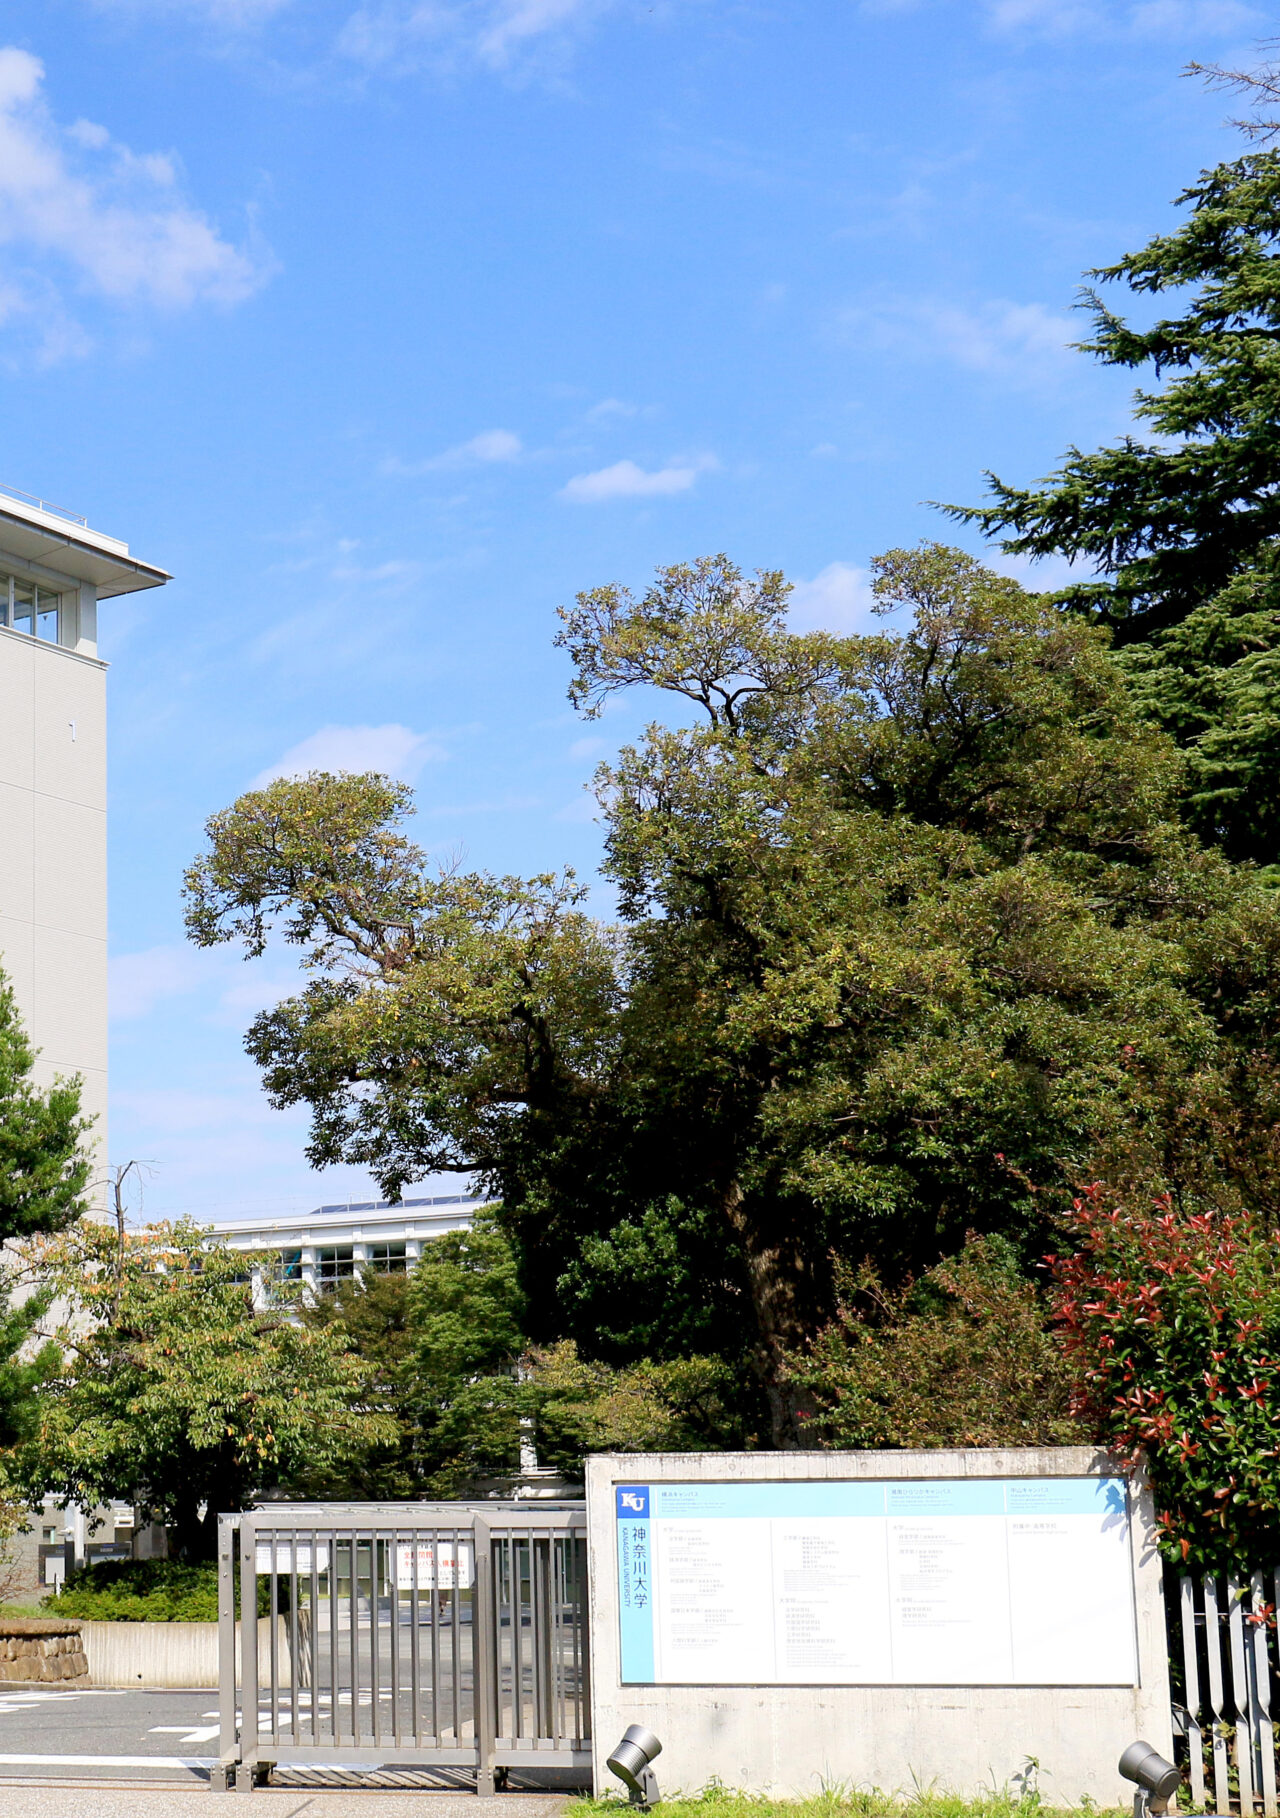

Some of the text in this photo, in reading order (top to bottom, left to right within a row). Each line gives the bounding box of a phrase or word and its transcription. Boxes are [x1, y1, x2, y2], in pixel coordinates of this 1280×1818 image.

[621, 1492, 646, 1512] KU
[622, 1527, 631, 1608] KANAGAWA UNIVERSITY
[632, 1526, 648, 1609] 神奈川大学
